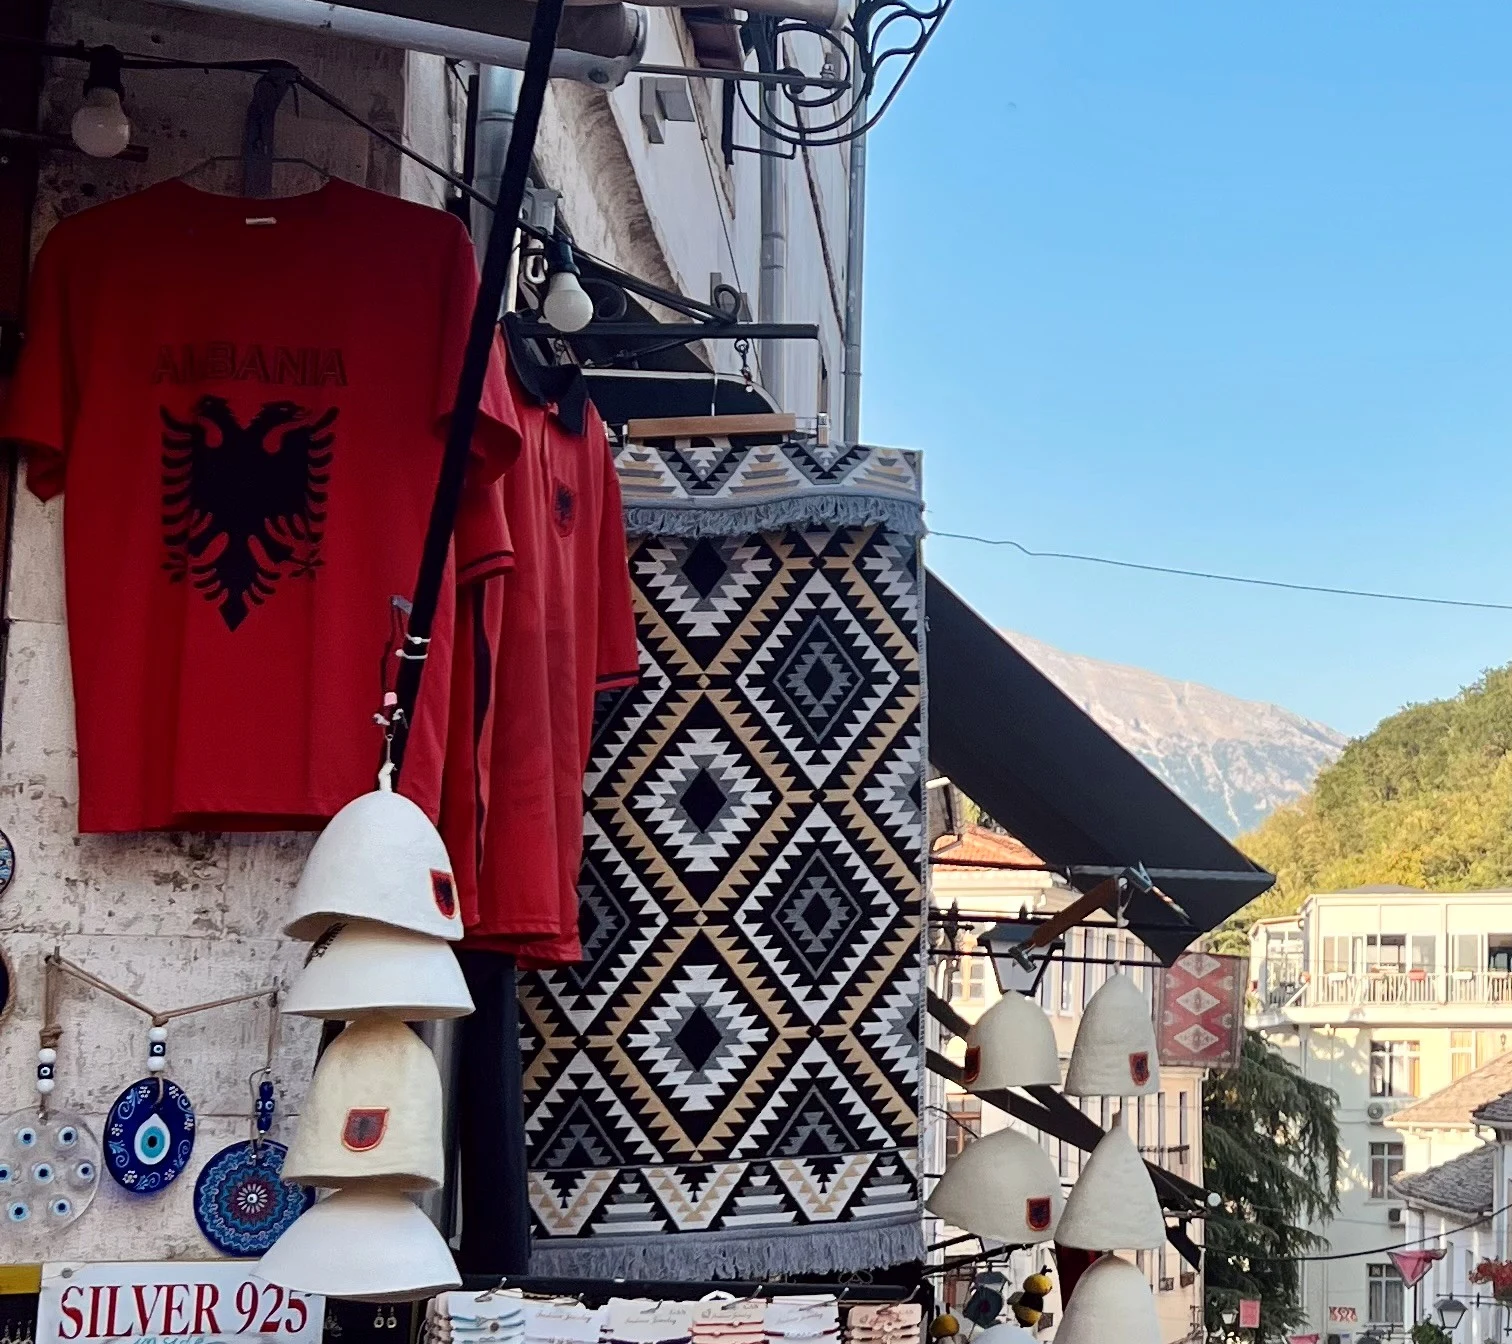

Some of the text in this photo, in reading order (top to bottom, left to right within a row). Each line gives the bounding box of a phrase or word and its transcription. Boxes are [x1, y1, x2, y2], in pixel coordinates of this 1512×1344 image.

[151, 340, 349, 387] ALBANIA
[58, 1281, 308, 1340] SILVER 925
